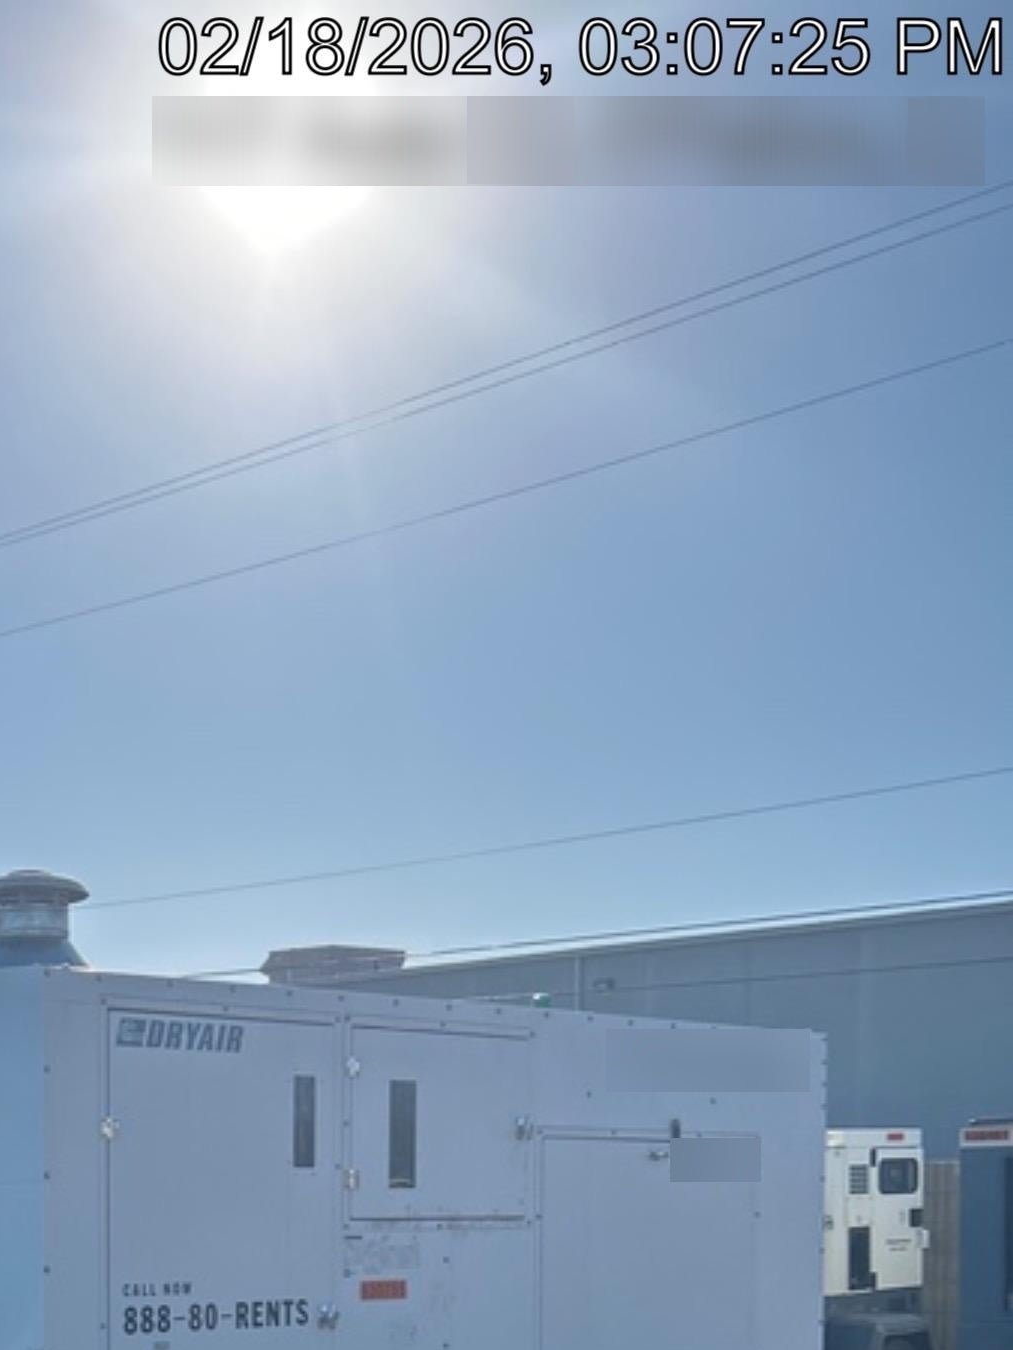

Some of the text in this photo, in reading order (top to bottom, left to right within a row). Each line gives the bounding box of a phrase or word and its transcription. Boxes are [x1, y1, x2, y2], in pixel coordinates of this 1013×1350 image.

[146, 1019, 244, 1053] DRYAIR
[122, 1282, 192, 1297] CALL NOW
[123, 1299, 310, 1335] 888-80-RENTS
